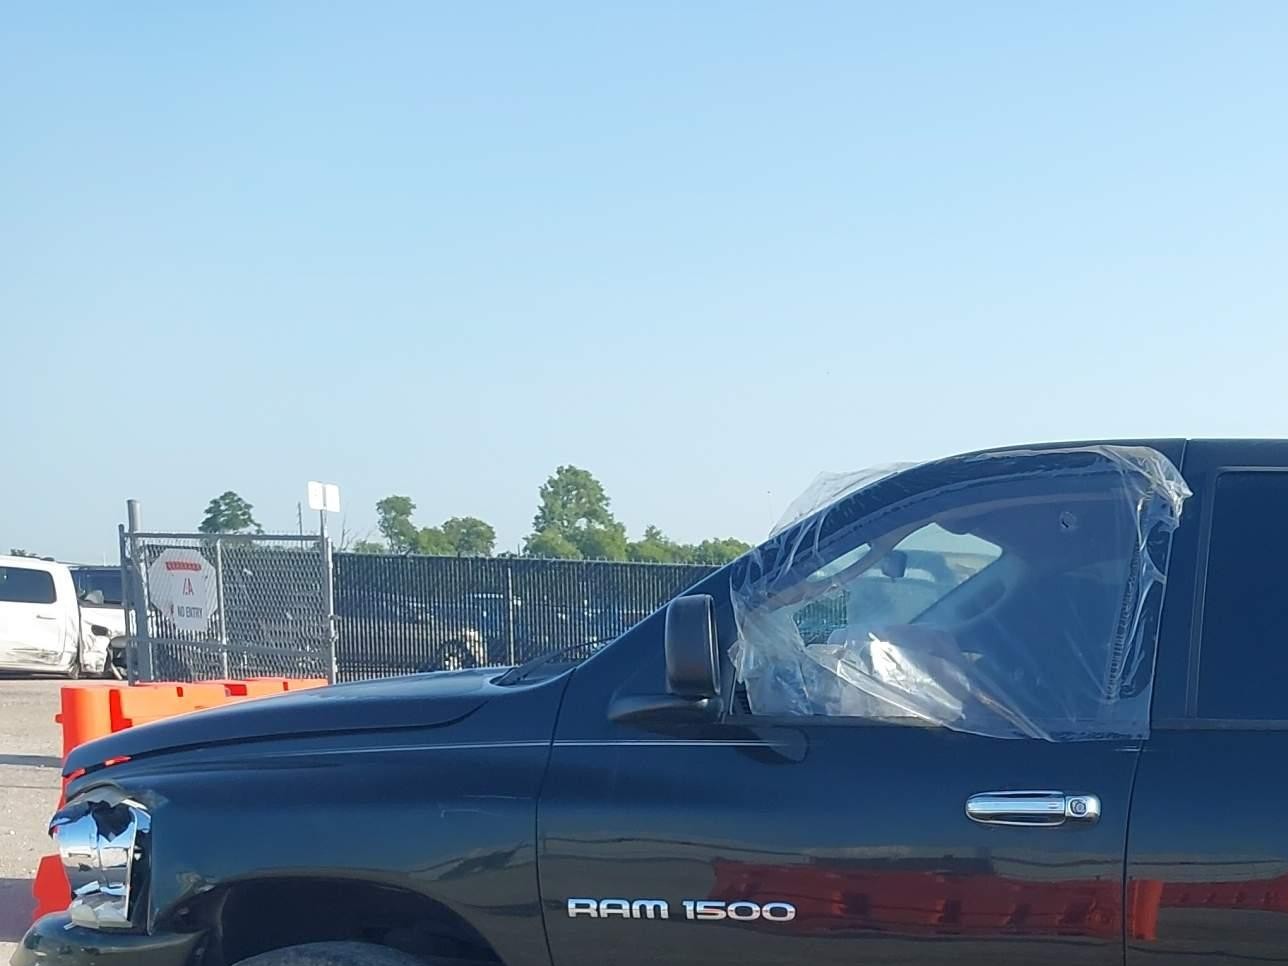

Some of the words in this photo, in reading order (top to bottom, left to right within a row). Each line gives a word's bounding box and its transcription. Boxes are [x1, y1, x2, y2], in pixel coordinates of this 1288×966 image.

[177, 606, 185, 618] NO
[186, 606, 203, 619] ENTRY
[567, 898, 670, 919] RAM
[682, 899, 797, 922] 1500
